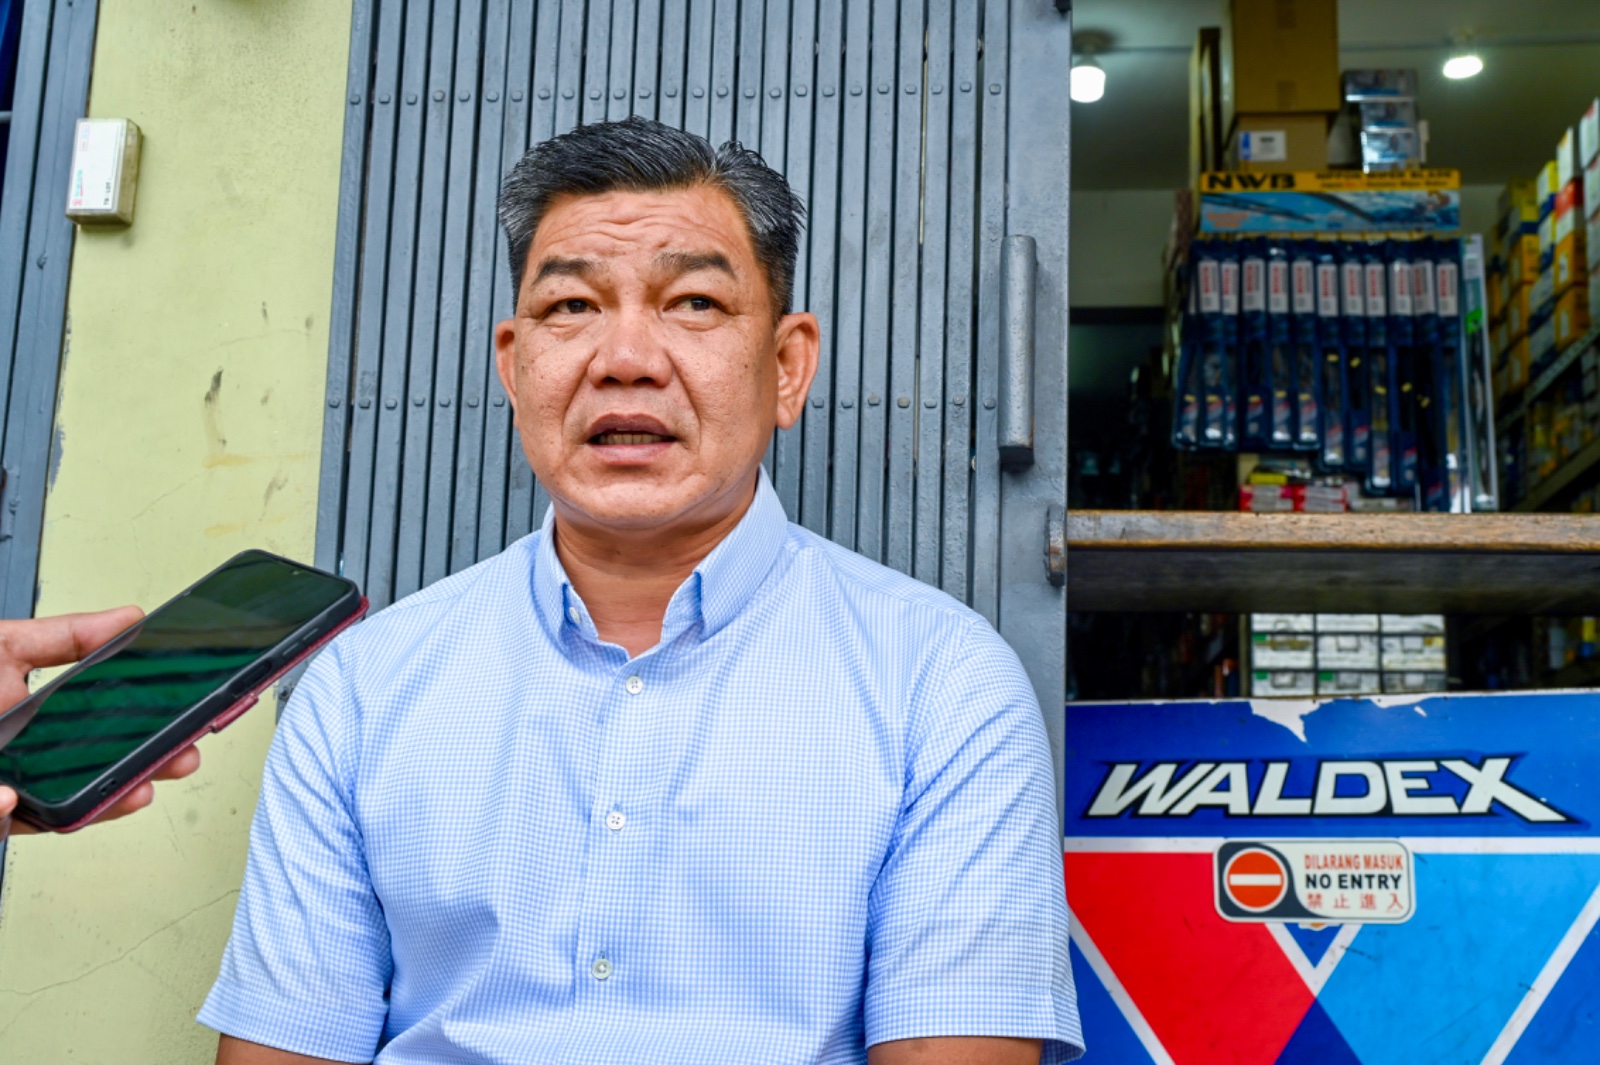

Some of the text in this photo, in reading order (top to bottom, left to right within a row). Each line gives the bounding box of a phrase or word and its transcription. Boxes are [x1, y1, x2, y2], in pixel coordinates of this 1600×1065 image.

[1208, 174, 1296, 189] NWB
[1085, 757, 1569, 822] WALDEX
[1304, 854, 1403, 870] DILARANG MASUK
[1306, 874, 1402, 889] NO ENTRY
[1306, 893, 1404, 910] 禁止進入
